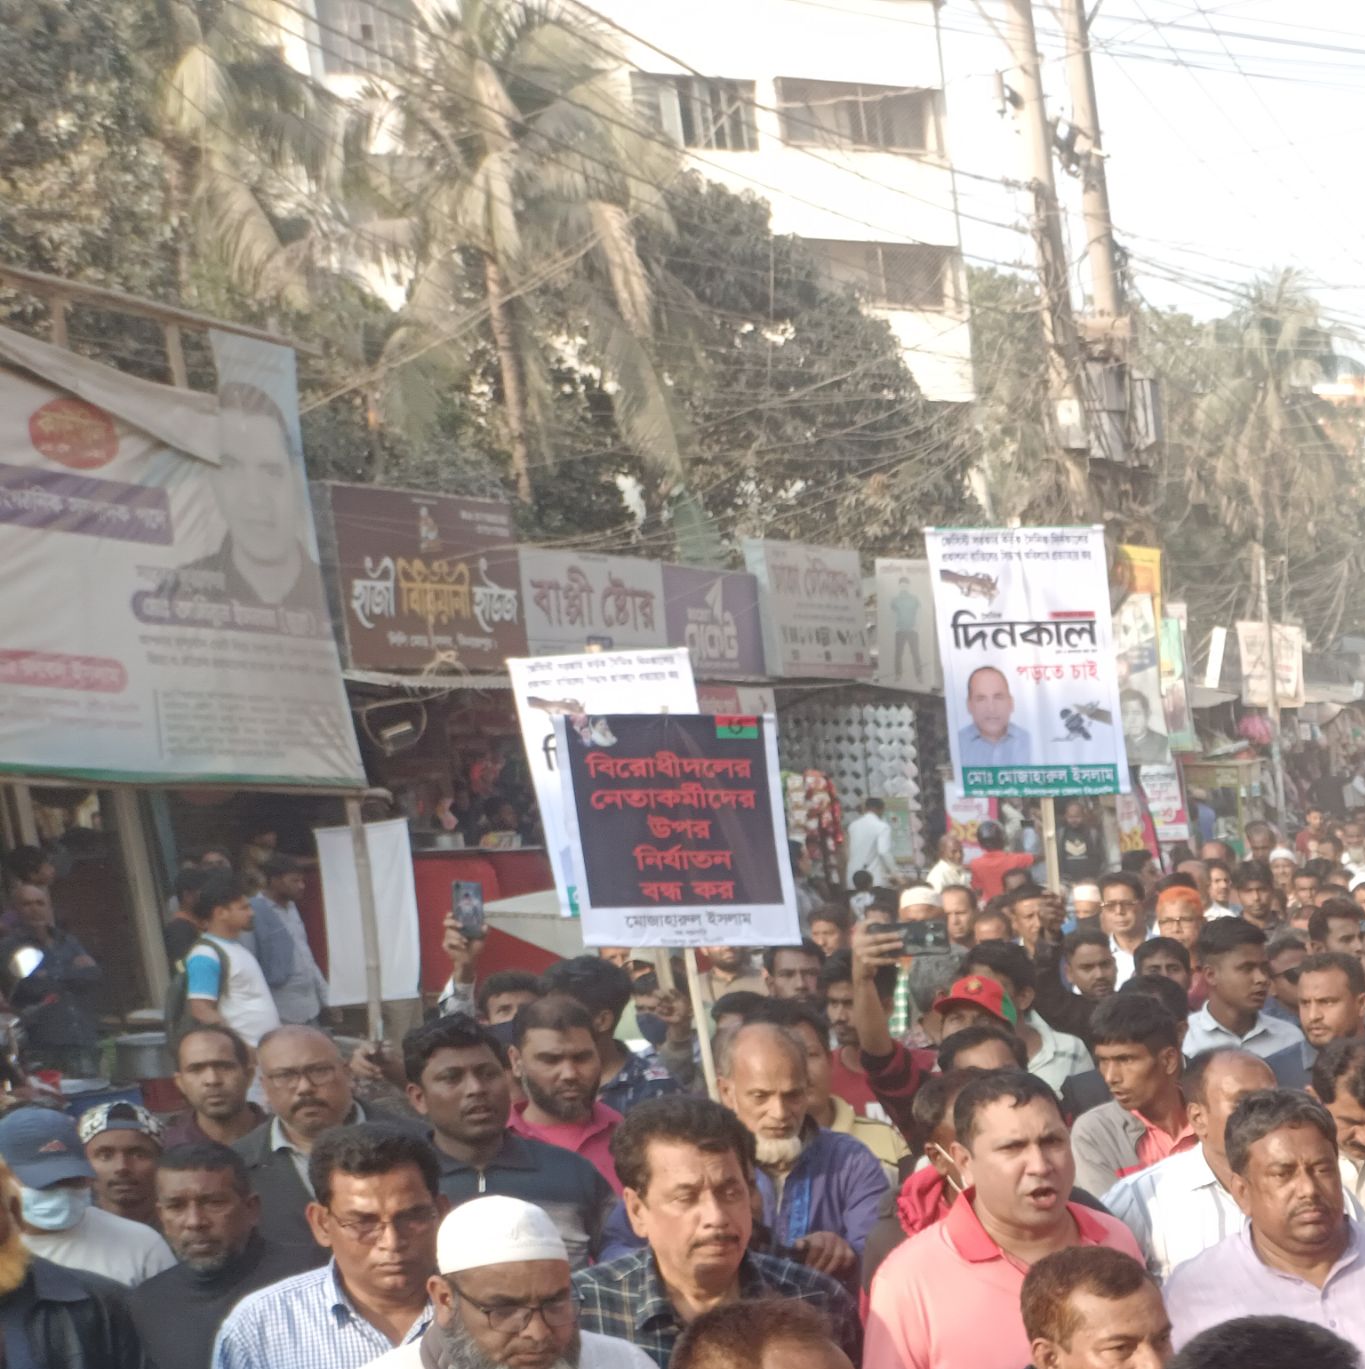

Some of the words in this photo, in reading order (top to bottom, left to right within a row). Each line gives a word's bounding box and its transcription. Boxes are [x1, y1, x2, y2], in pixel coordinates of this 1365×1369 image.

[951, 610, 1096, 650] দিনকাল
[1072, 660, 1098, 680] চাই
[585, 751, 751, 779] বিরোধীদলের
[1072, 766, 1113, 782] ইসলাম
[590, 783, 755, 809] নেতাকর্মীদের
[647, 814, 711, 839] উপর
[633, 844, 732, 871] নির্যাতন
[640, 881, 682, 901] বন্ধ
[692, 880, 734, 899] কর
[707, 911, 751, 926] ইসলাম
